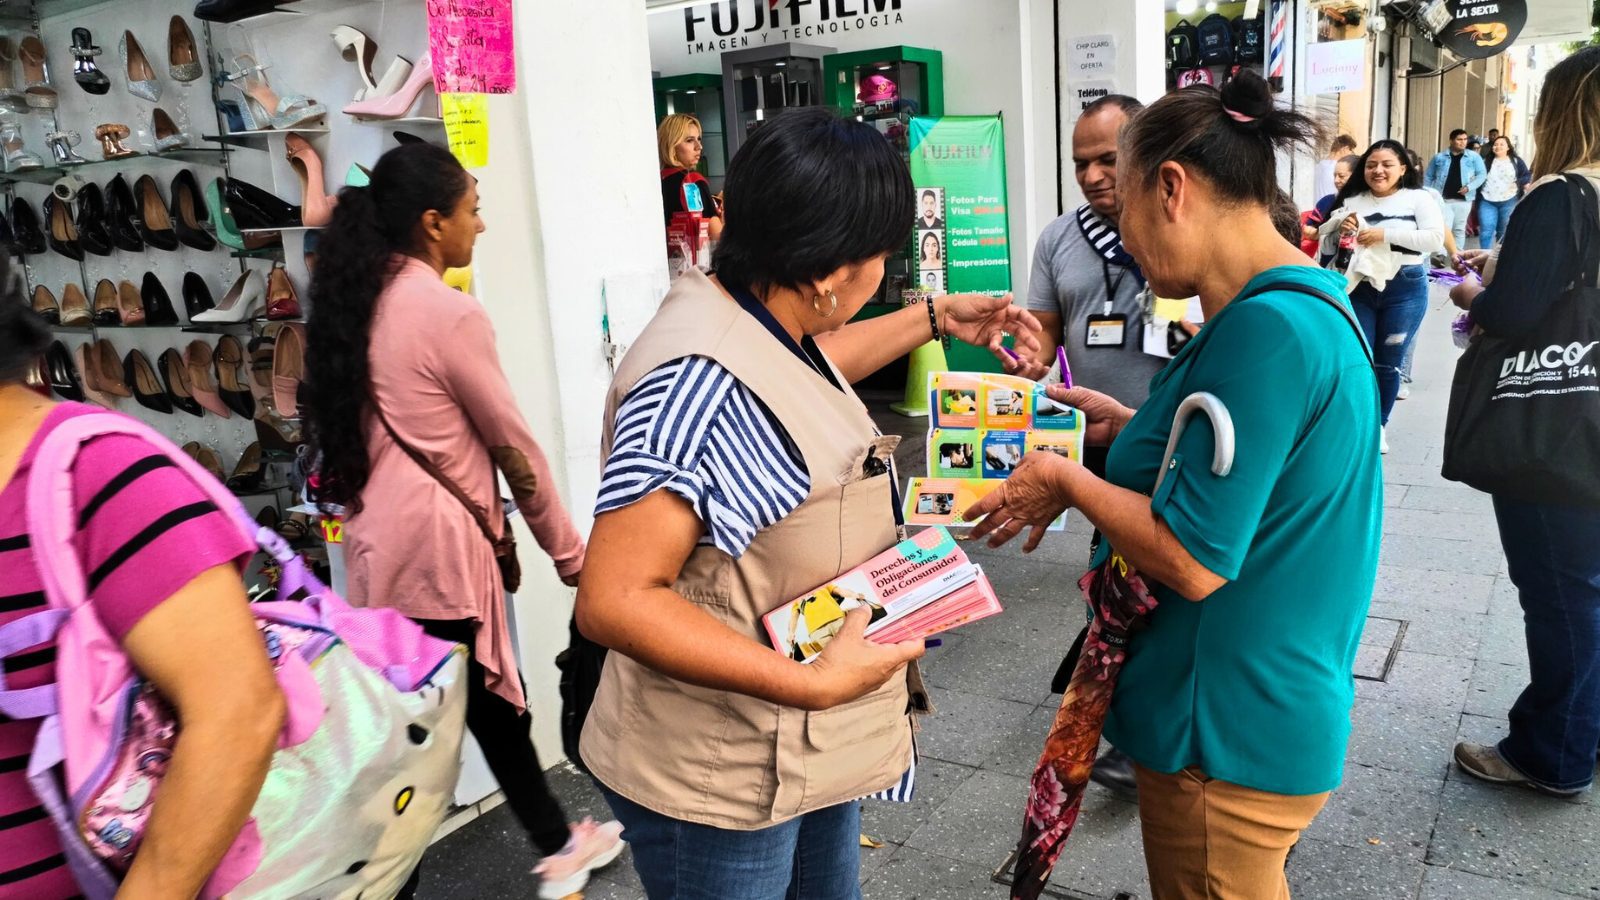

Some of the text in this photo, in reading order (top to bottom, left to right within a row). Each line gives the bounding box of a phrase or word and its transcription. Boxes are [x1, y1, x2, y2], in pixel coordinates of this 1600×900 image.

[1456, 4, 1499, 19] LA SEXTA
[687, 12, 903, 55] IMAGEN Y TECNOLOGIA
[1076, 43, 1090, 51] CHIP
[1080, 62, 1103, 70] OFERTA
[1077, 87, 1108, 98] Teléfono
[923, 144, 992, 160] FUJIFILM
[977, 195, 998, 204] Para
[951, 207, 971, 215] Visa
[974, 226, 1004, 235] Tamaño
[1500, 341, 1599, 378] DIACO
[1568, 364, 1597, 379] 1544
[870, 549, 923, 579] Derechos y
[876, 553, 939, 588] Obligaciones
[882, 554, 958, 598] del Consumidor
